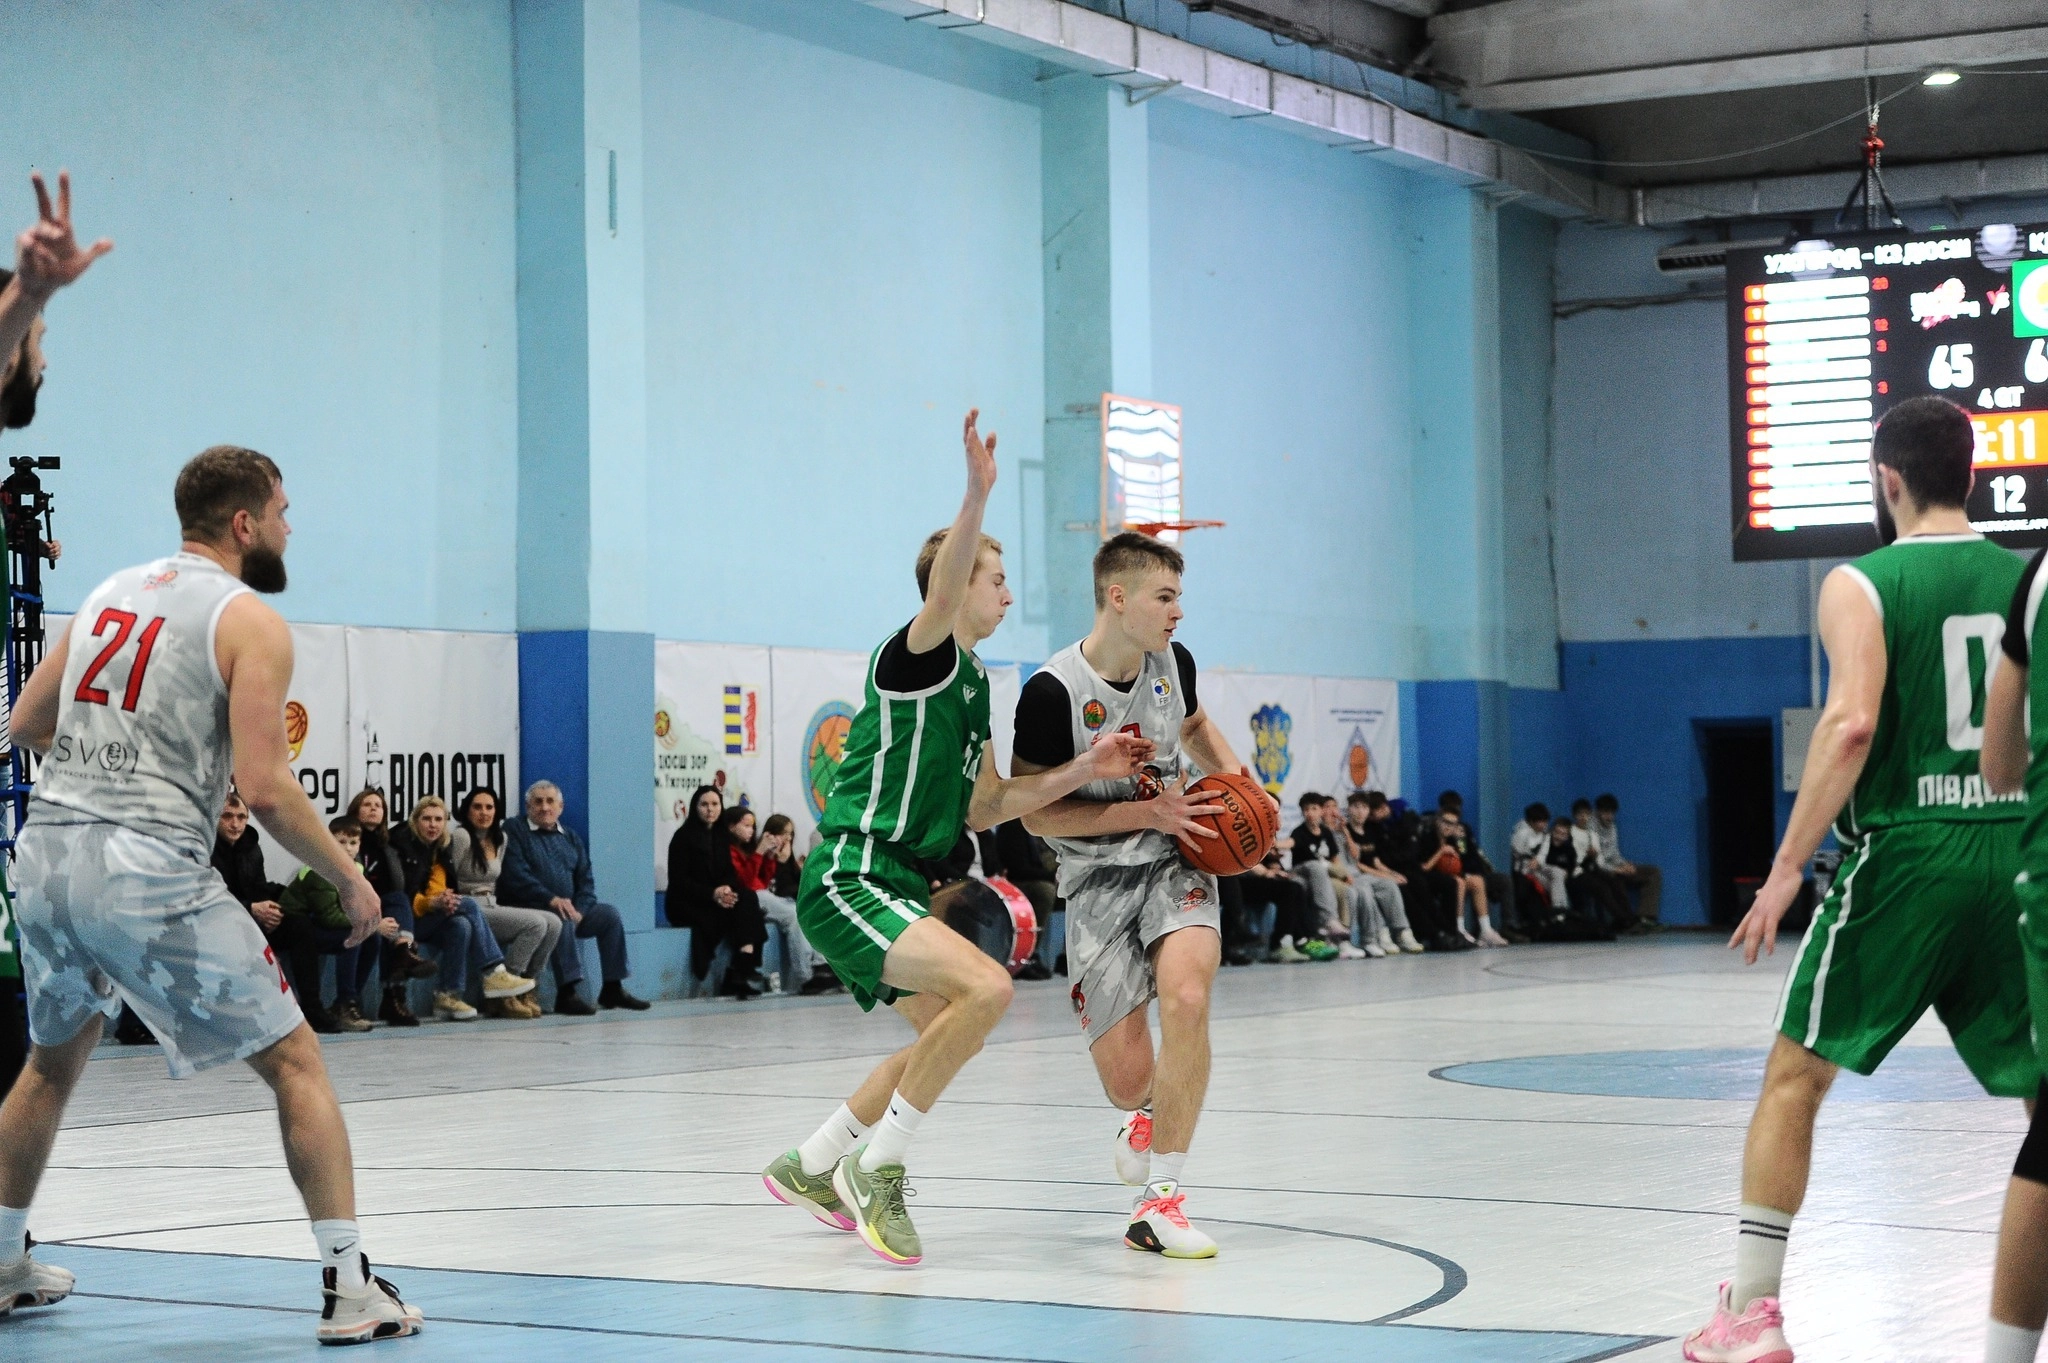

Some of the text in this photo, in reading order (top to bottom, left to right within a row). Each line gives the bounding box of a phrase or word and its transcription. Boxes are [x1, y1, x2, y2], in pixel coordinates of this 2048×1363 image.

[1928, 343, 1975, 389] 65
[2024, 338, 2048, 384] 6
[1990, 475, 2027, 513] 12
[74, 607, 166, 713] 21
[1220, 790, 1259, 857] Wilson
